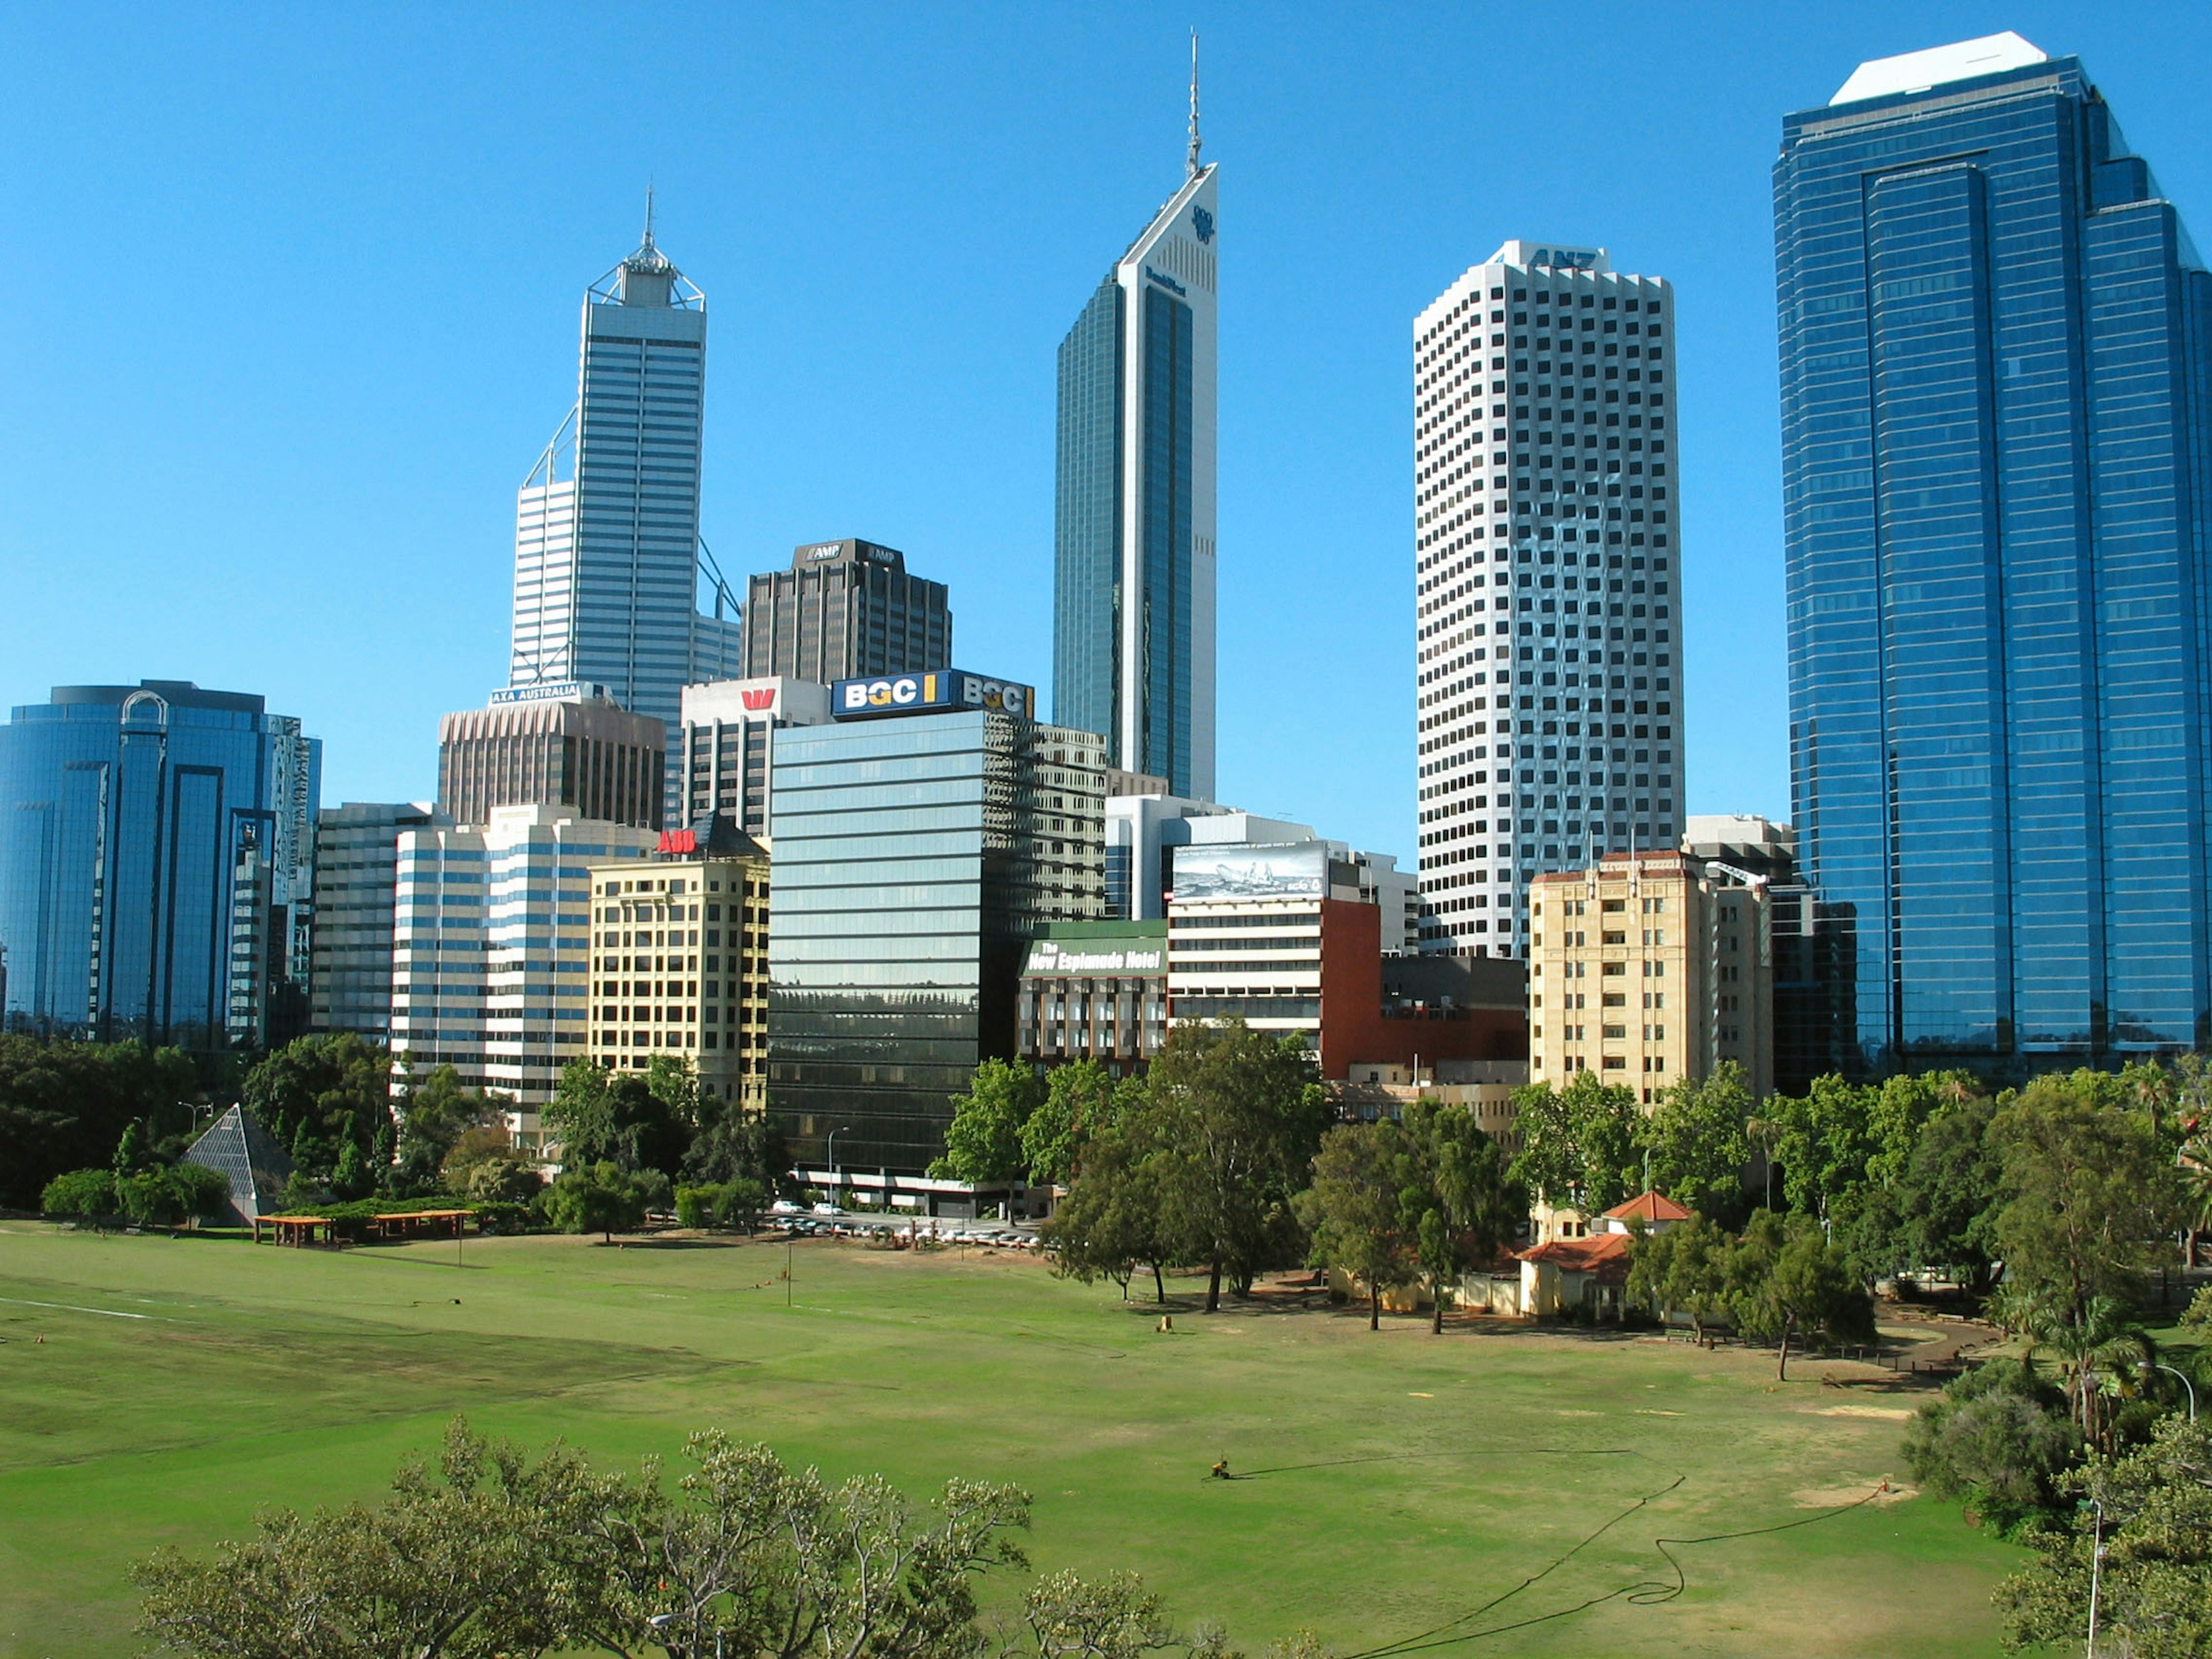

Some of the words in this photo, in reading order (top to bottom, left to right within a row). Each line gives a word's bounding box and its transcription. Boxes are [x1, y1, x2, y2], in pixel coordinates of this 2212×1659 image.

[814, 544, 840, 559] AMP
[493, 691, 515, 702] AXA
[519, 684, 576, 700] AUSTRALIA
[846, 679, 916, 708] BGC
[964, 676, 1024, 712] BGC
[657, 830, 696, 853] ABB
[1042, 943, 1058, 954] The
[1028, 953, 1056, 971] New
[1058, 951, 1123, 972] Esplanade
[1125, 950, 1161, 969] Hotel
